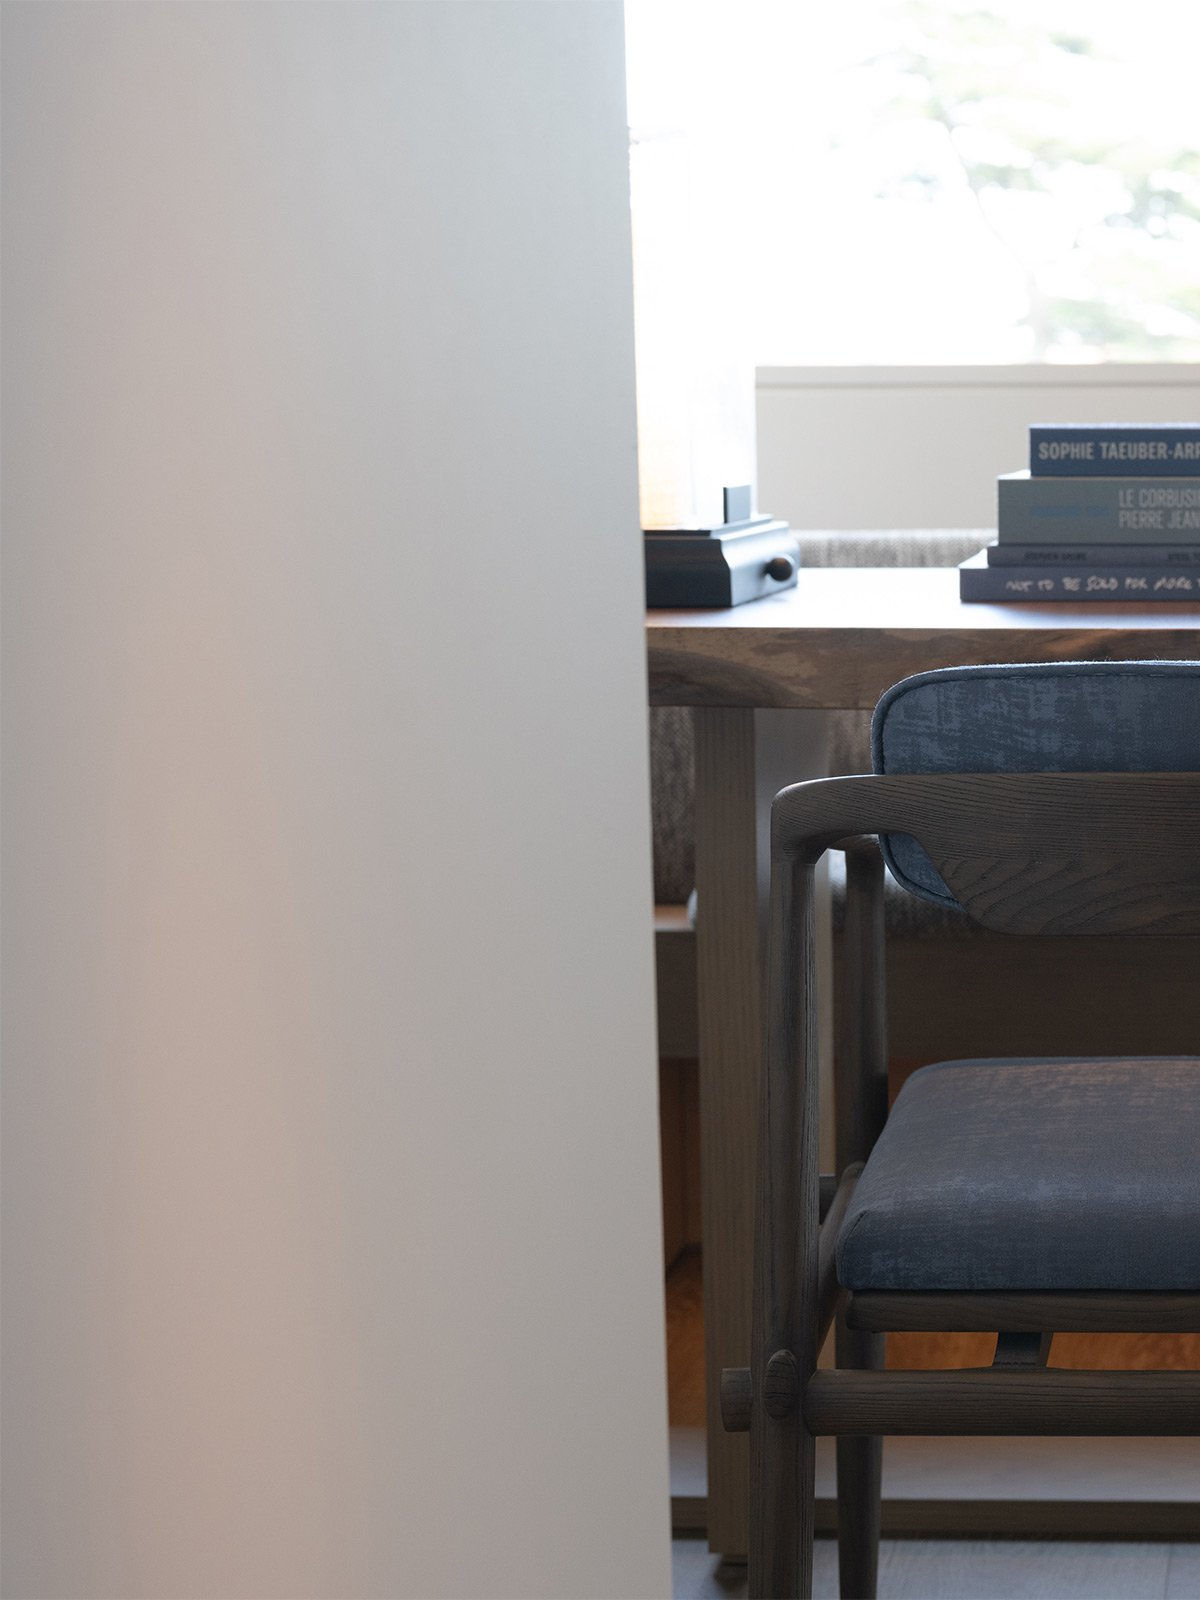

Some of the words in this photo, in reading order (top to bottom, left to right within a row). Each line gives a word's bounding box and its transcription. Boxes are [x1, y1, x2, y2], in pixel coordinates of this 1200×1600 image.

[1038, 442, 1095, 460] SOPHIE
[1118, 489, 1135, 508] LE
[1118, 510, 1164, 529] PIERRE
[1006, 580, 1032, 592] NOT
[1037, 579, 1054, 591] TO
[1062, 576, 1081, 591] BE
[1086, 575, 1118, 591] SOLD
[1124, 576, 1148, 590] FOR
[1153, 576, 1192, 591] MORE
